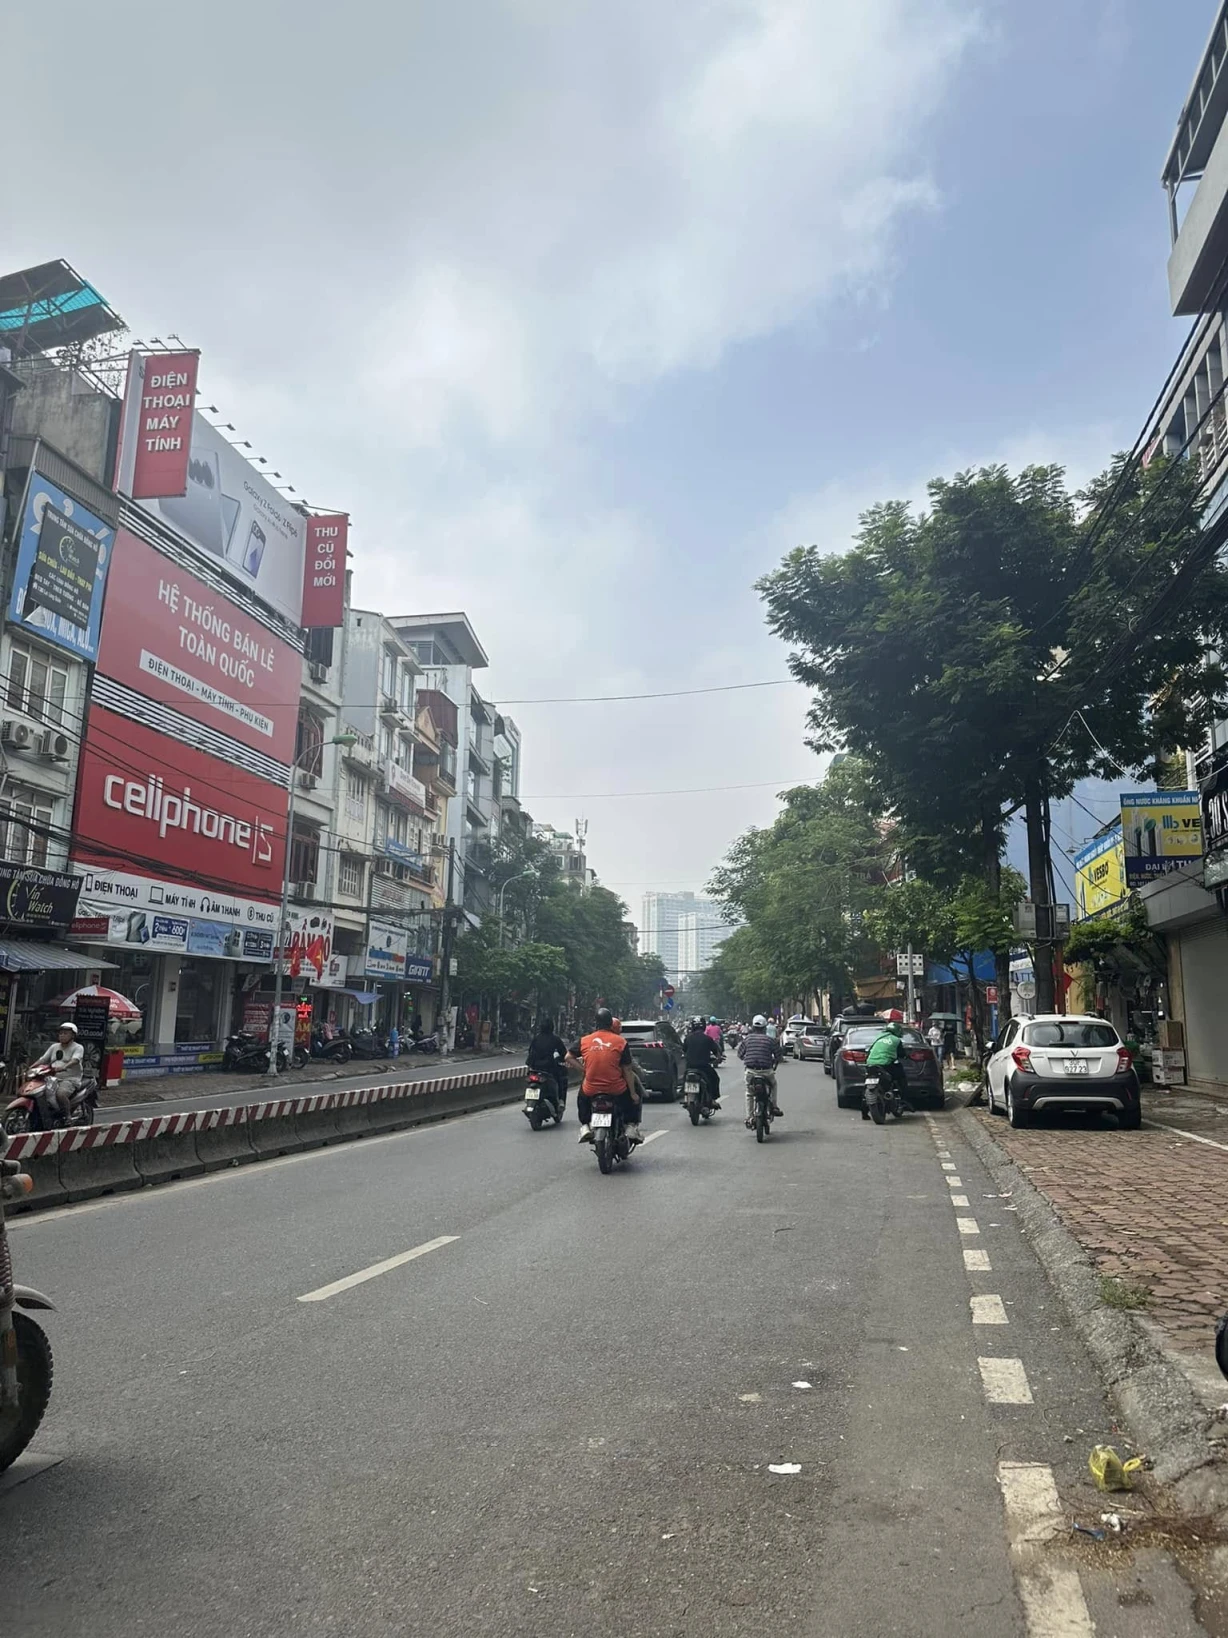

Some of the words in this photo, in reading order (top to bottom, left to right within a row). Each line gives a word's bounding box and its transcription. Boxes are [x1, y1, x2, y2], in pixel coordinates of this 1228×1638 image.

[151, 371, 188, 388] ĐIỆN
[143, 394, 190, 409] THOẠI
[146, 415, 179, 430] MÁY
[146, 435, 181, 451] TÍNH
[315, 527, 338, 537] THU
[317, 541, 334, 553] CŨ
[315, 555, 335, 570] ĐỔI
[314, 573, 335, 586] MỚI
[158, 580, 180, 613] HỆ
[184, 595, 230, 642] THỐNG
[233, 629, 259, 661] BÁN
[260, 647, 275, 672] LẺ
[178, 626, 216, 666] TOÀN
[219, 653, 255, 688] QUỐC
[148, 657, 169, 678] ĐIỆN
[170, 668, 195, 692] THOẠI
[200, 686, 217, 703] MÁY
[217, 693, 234, 712] TÍNH
[239, 707, 254, 723] PHỤ
[254, 714, 269, 731] KIỆN
[28, 900, 53, 914] Watch
[94, 878, 113, 895] ĐIỆN
[115, 884, 139, 900] THOẠI
[165, 894, 180, 905] MÁY
[210, 902, 221, 914] ÂM
[256, 912, 267, 922] THU
